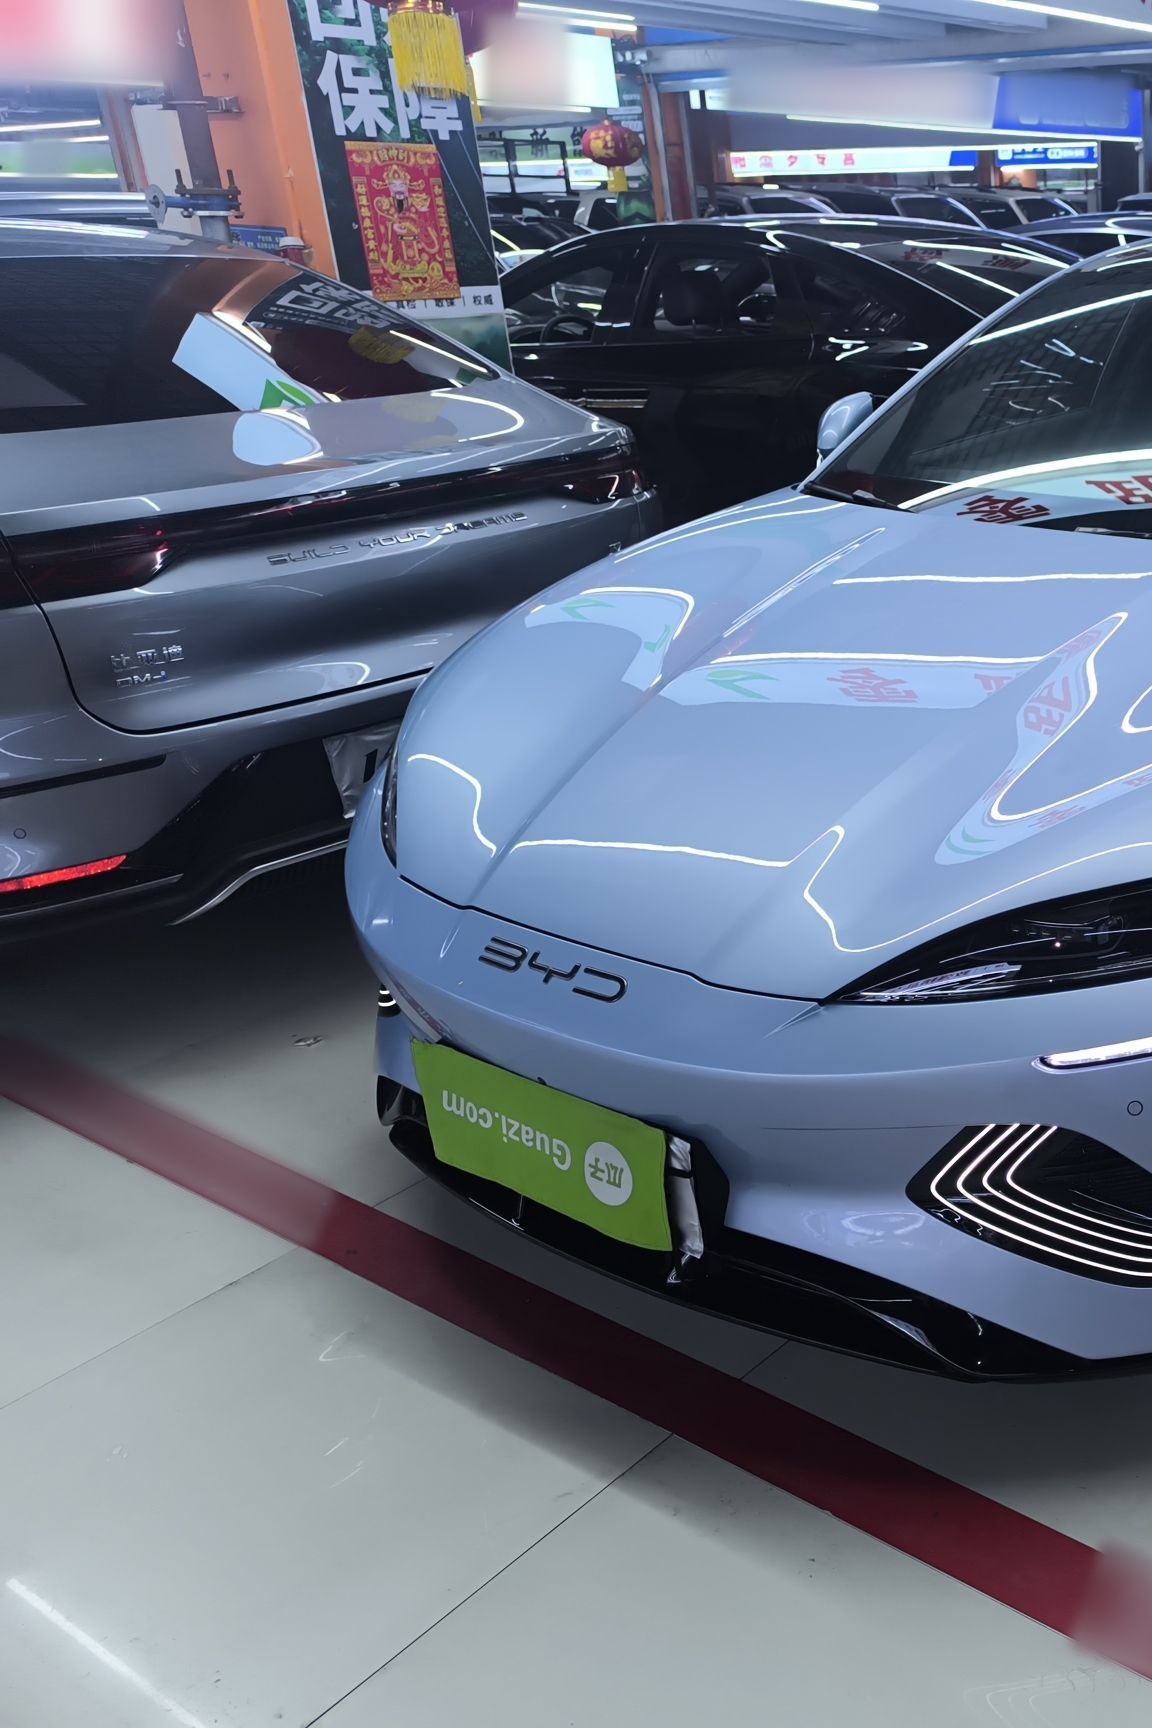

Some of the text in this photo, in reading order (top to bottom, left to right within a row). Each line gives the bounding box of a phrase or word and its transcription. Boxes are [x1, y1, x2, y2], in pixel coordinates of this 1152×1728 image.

[267, 511, 528, 566] BUILD YOUR DREAMS
[478, 936, 628, 1004] BYD
[441, 1088, 572, 1172] Guazi.com
[588, 1157, 624, 1189] 瓜子
